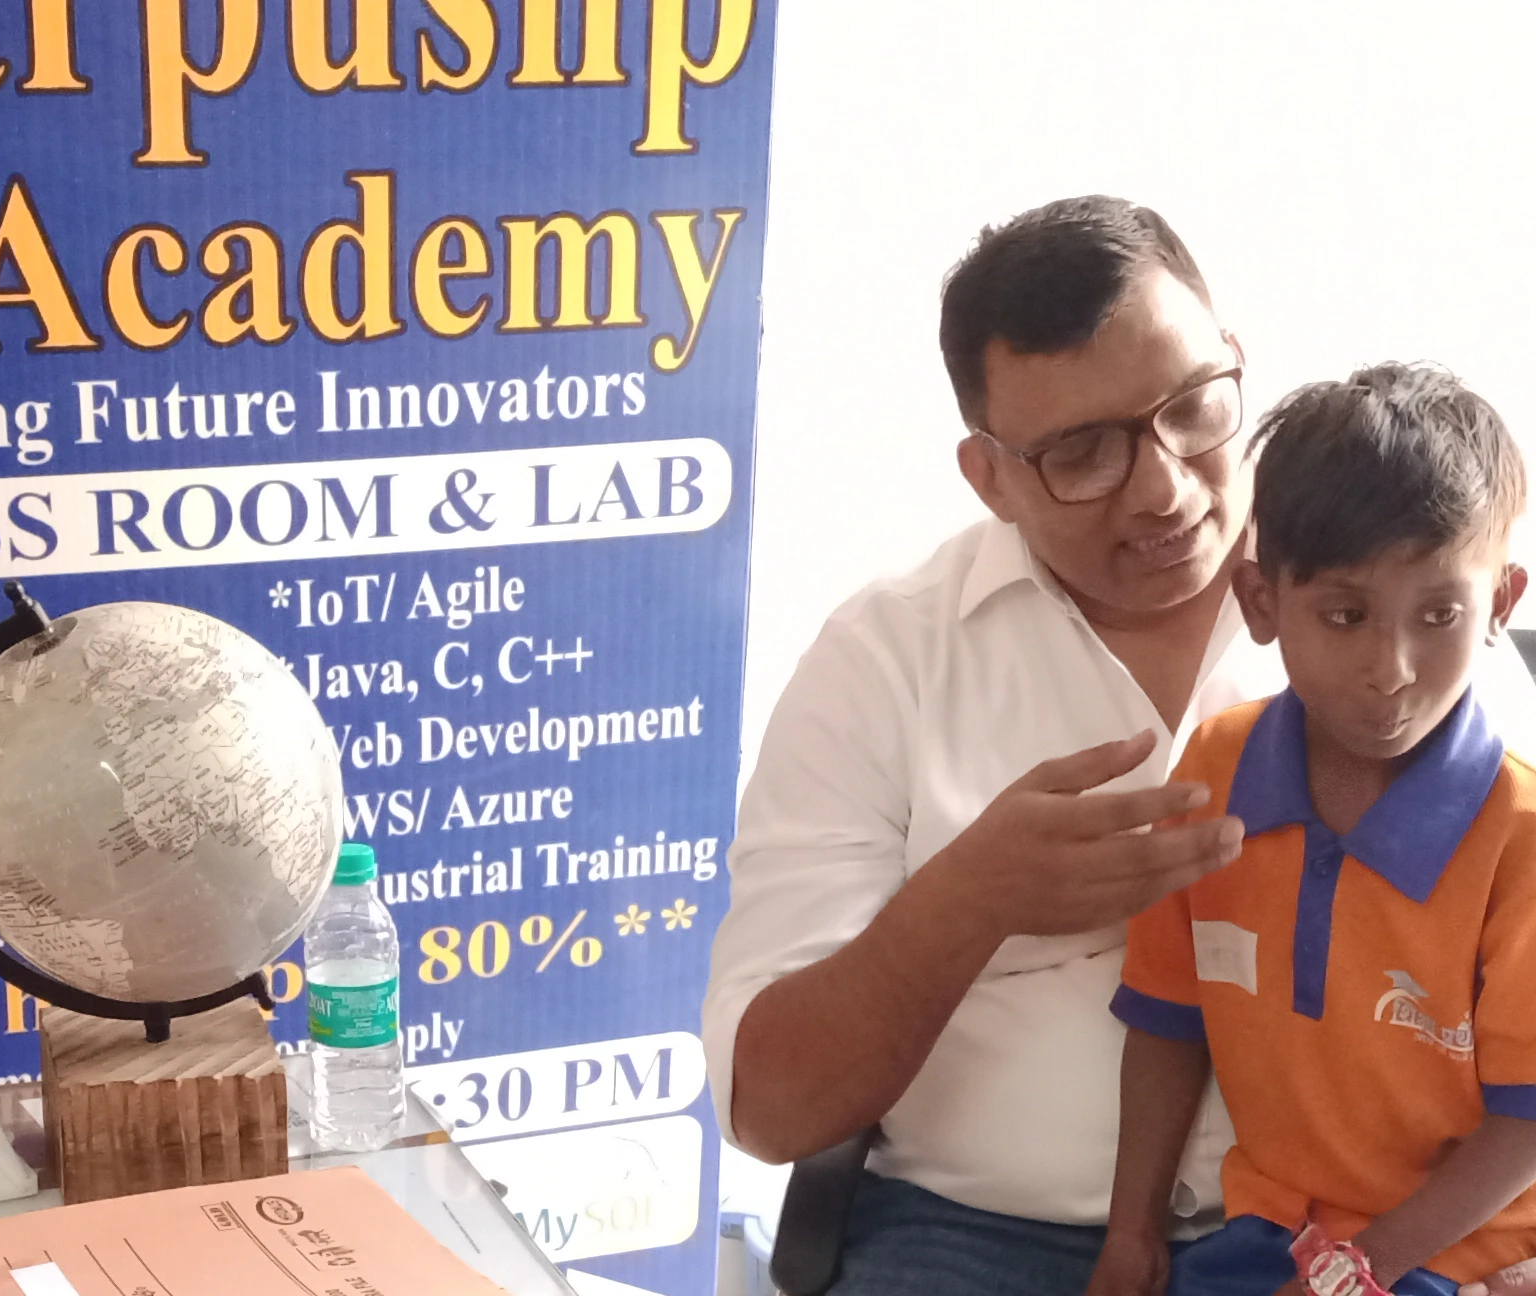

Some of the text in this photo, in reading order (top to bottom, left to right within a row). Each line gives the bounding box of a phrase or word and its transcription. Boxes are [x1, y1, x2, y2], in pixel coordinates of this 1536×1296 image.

[73, 376, 297, 446] Future
[316, 364, 646, 434] Innovators
[89, 472, 399, 557] ROOM
[427, 466, 498, 535] &
[526, 454, 704, 530] LAB
[407, 565, 526, 630] Agile
[433, 641, 485, 697] C,
[498, 636, 595, 684] C++
[419, 695, 705, 764] Development
[441, 784, 574, 831] Azure
[536, 830, 719, 889] Training
[560, 1046, 673, 1114] PM
